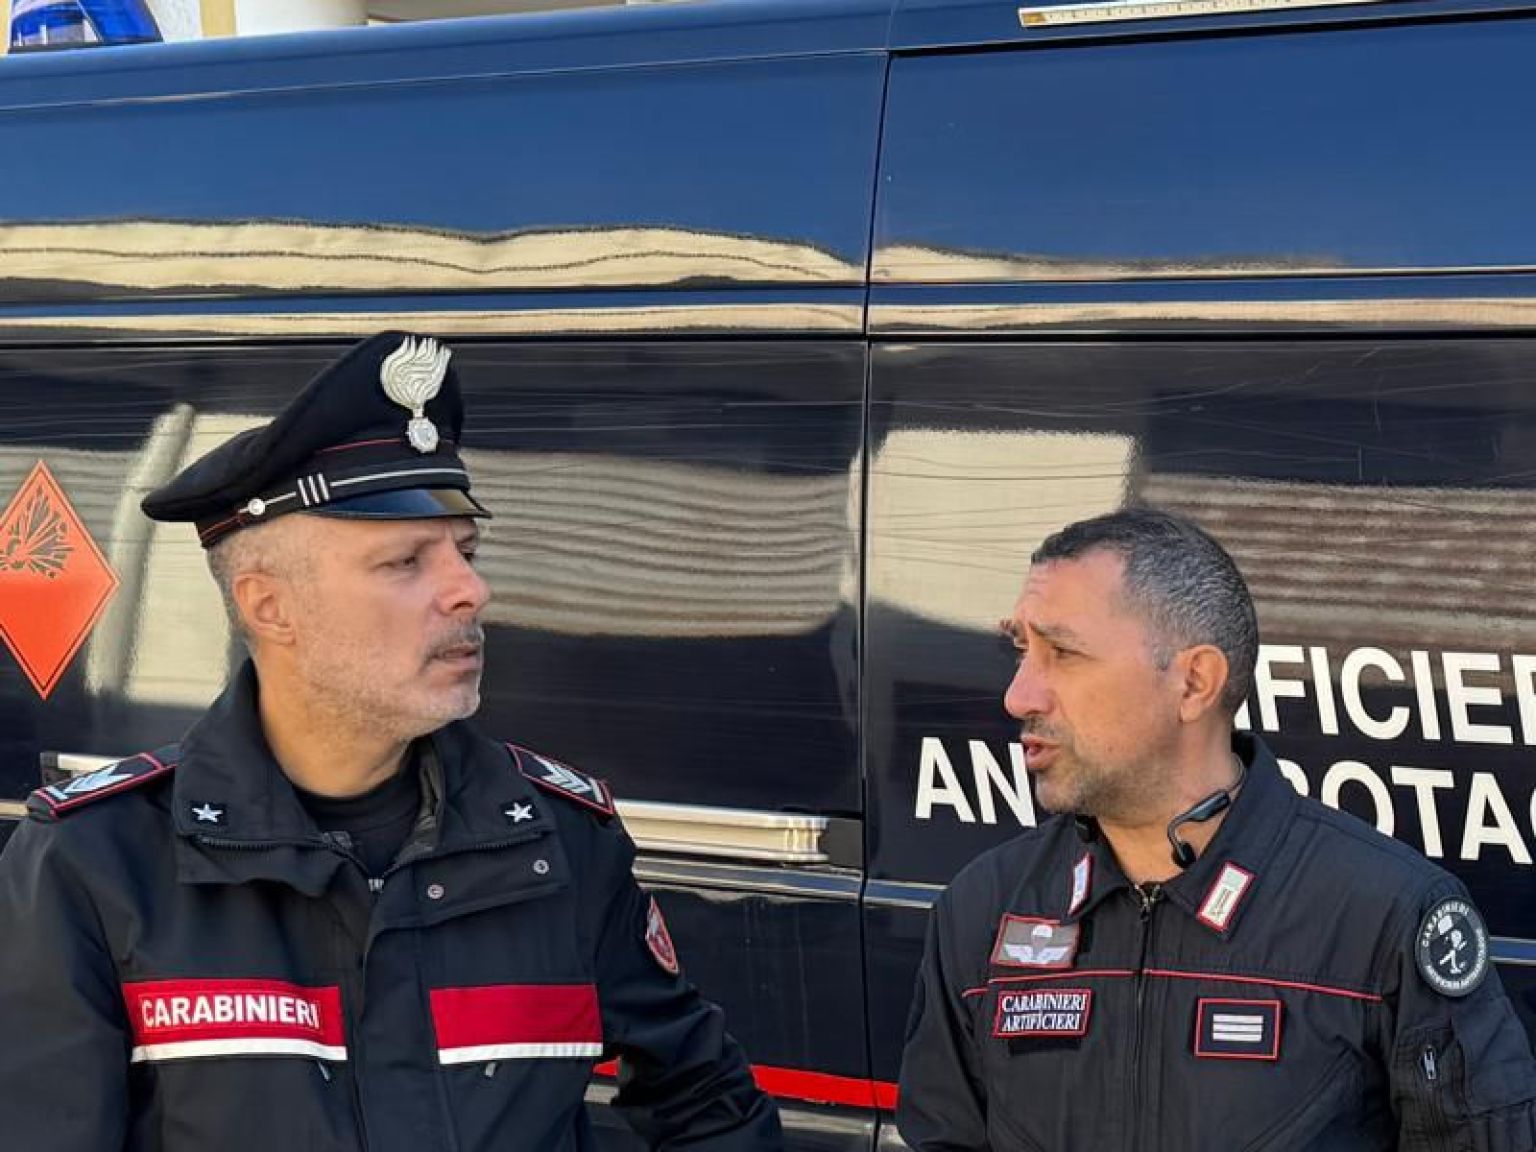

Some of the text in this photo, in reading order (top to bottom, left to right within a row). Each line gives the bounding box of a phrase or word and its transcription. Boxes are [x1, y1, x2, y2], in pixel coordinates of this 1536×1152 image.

[142, 994, 320, 1030] CARABINIERI
[1001, 993, 1087, 1012] CARABINIERI
[1001, 1013, 1081, 1032] ARTIFICIERI
